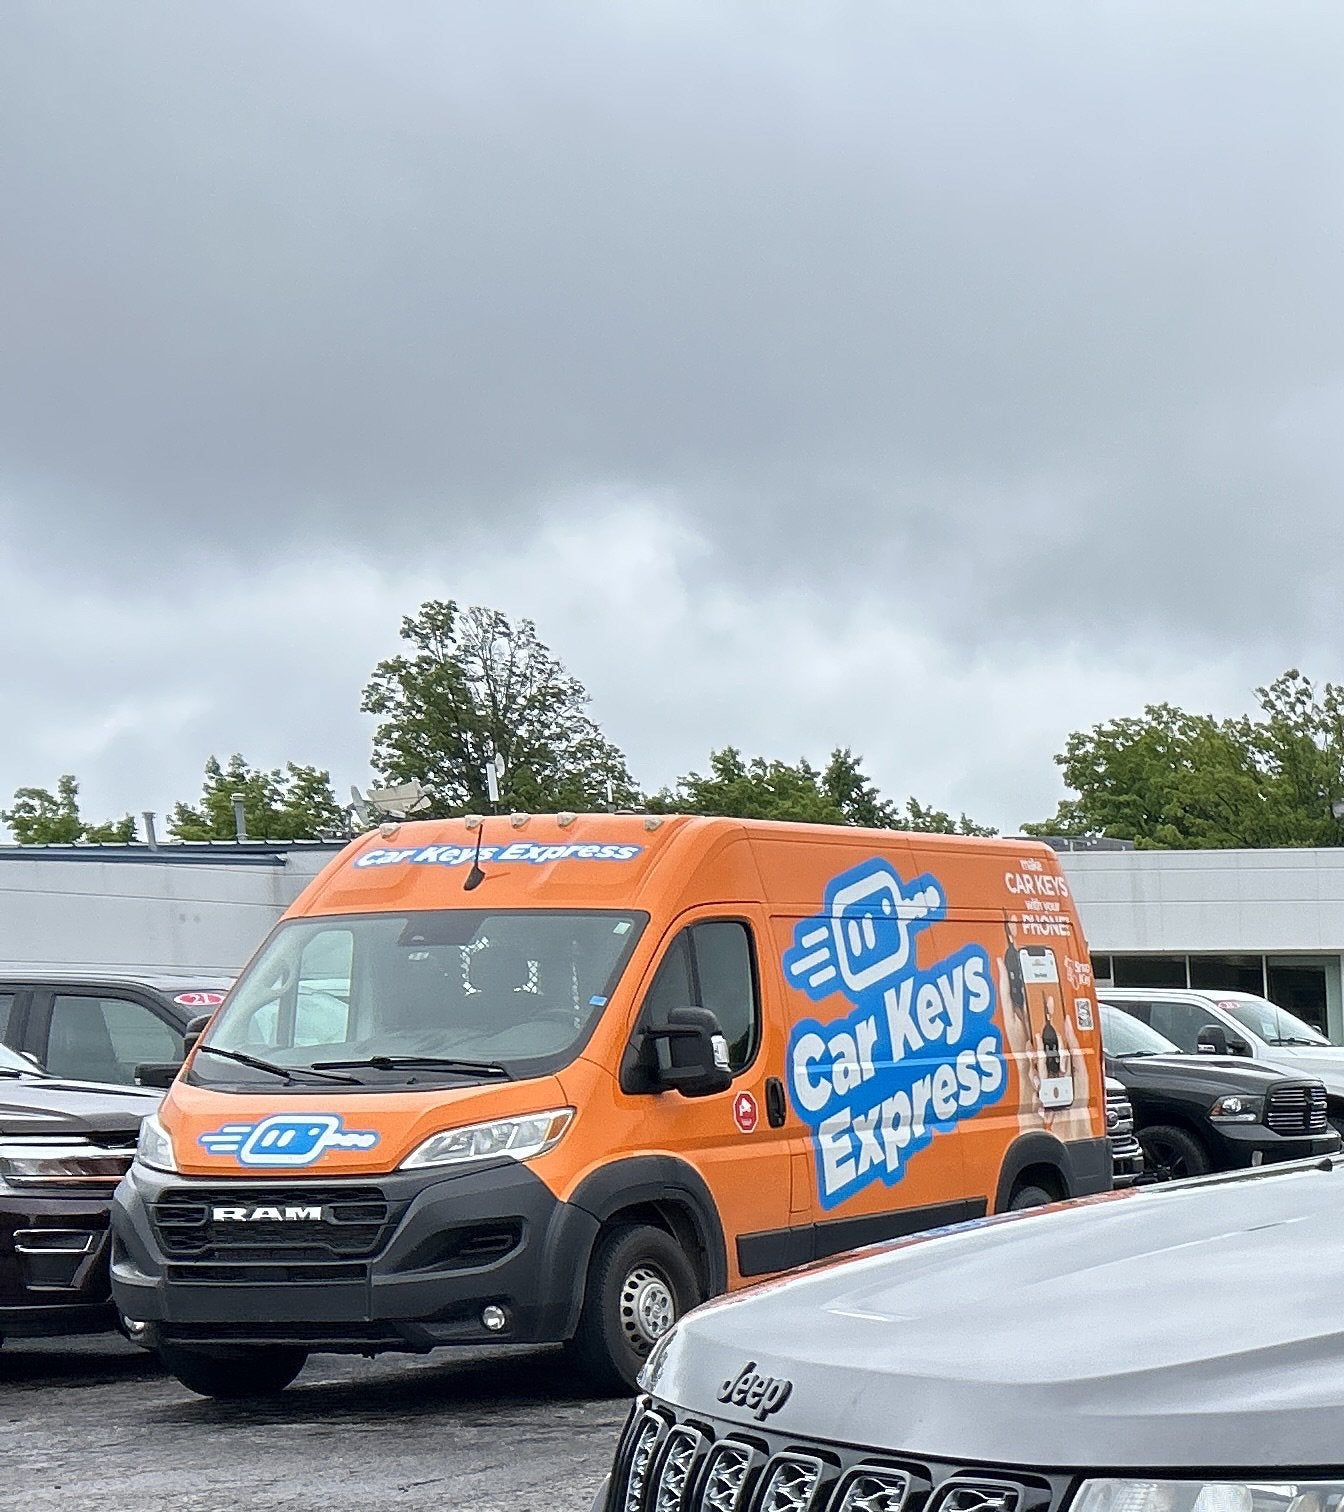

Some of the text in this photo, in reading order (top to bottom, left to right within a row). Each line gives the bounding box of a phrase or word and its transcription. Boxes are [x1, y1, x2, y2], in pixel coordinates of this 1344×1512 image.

[357, 843, 642, 866] Car Keys Express
[1004, 872, 1069, 898] CAR KEYS
[793, 956, 992, 1112] Car Keys
[818, 1036, 1003, 1197] Express
[213, 1206, 322, 1222] RAM
[717, 1361, 793, 1422] Jeep
